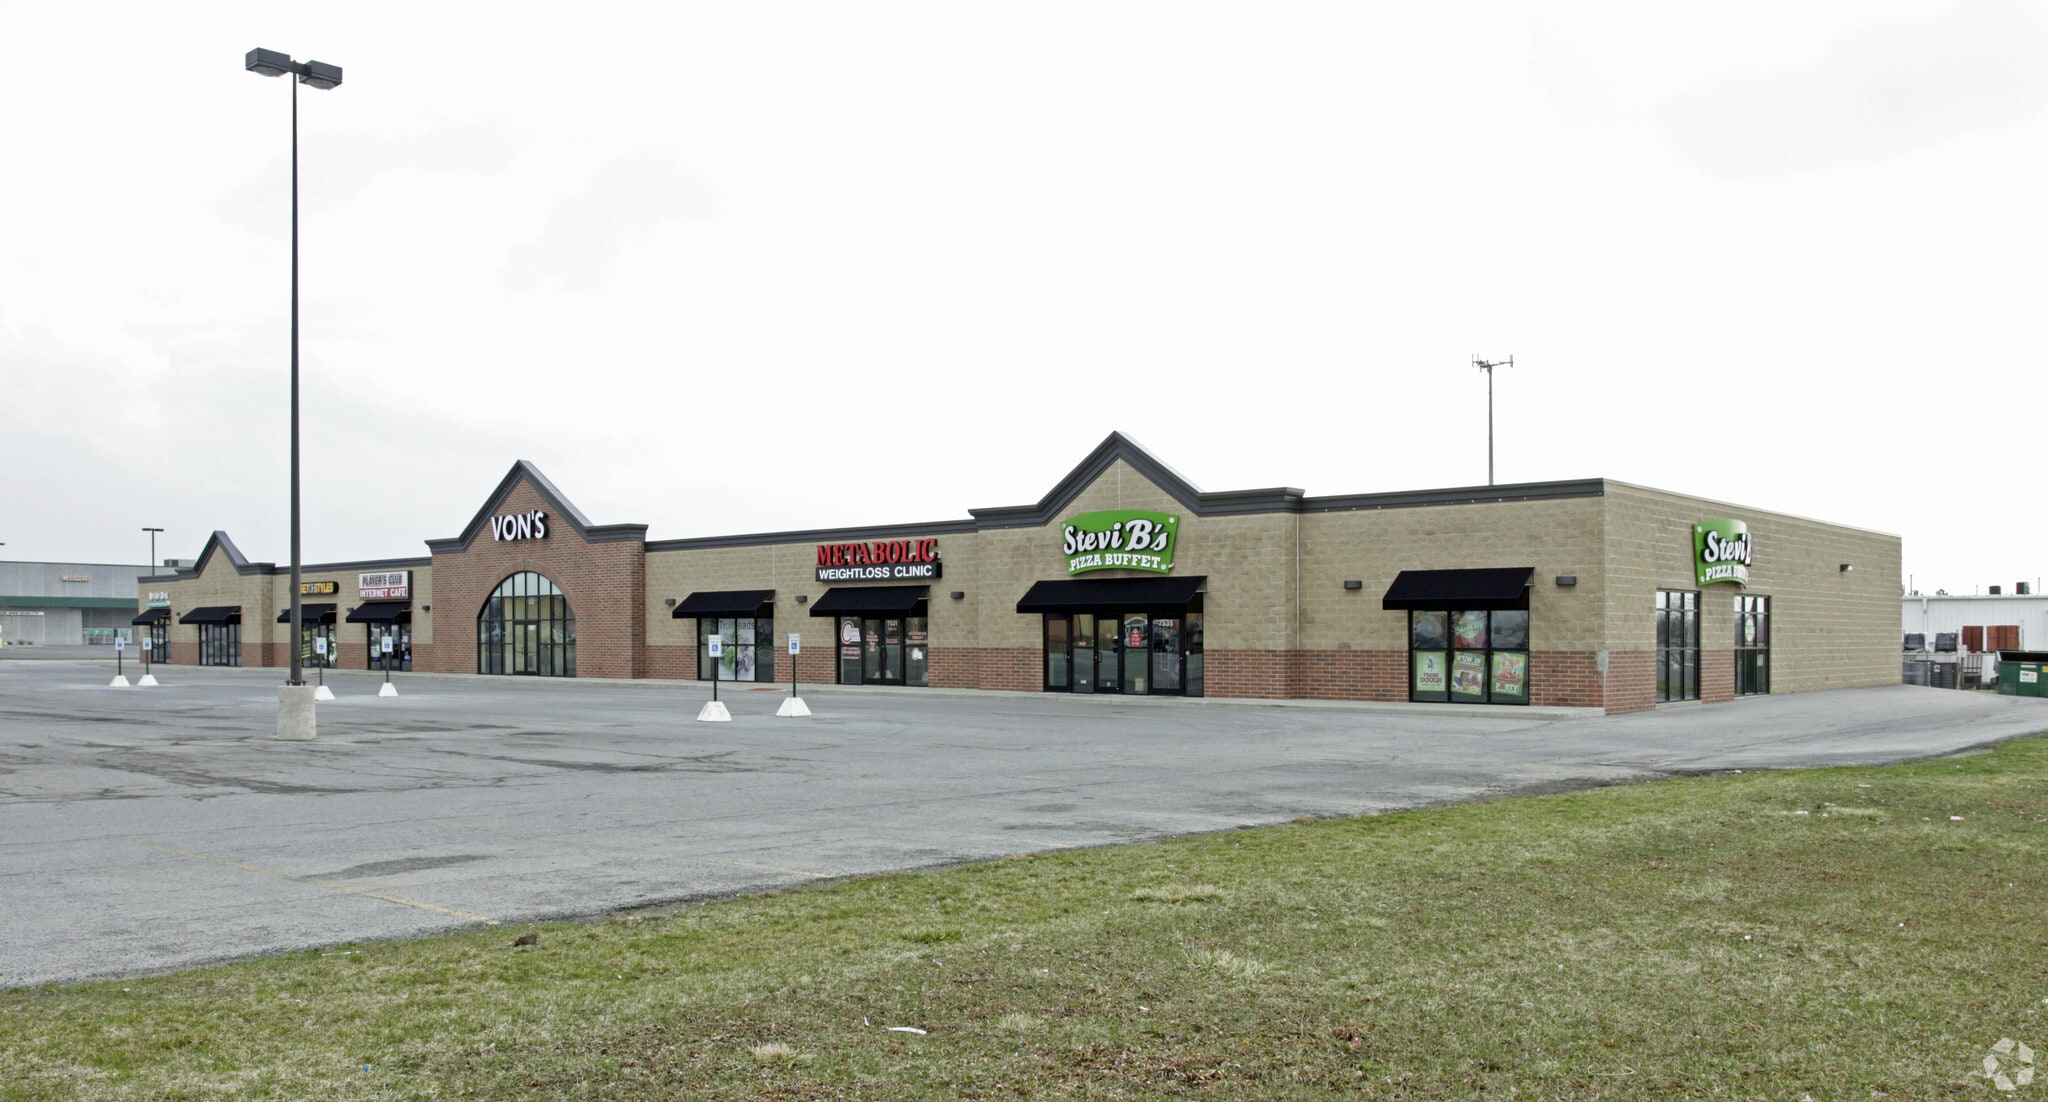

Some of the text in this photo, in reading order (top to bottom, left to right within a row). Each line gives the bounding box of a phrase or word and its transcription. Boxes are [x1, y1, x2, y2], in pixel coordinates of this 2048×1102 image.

[491, 510, 545, 541] VON'S
[1063, 519, 1168, 555] Stevi B's
[816, 539, 938, 566] METABOLIC
[1070, 553, 1161, 572] PIZZA BUFFET
[362, 573, 403, 587] PLAYER'S CLUB
[819, 565, 932, 580] WEIGHTLOSS CLINIC
[1705, 564, 1732, 581] PIZZA
[360, 587, 406, 598] INTERNET CAFE
